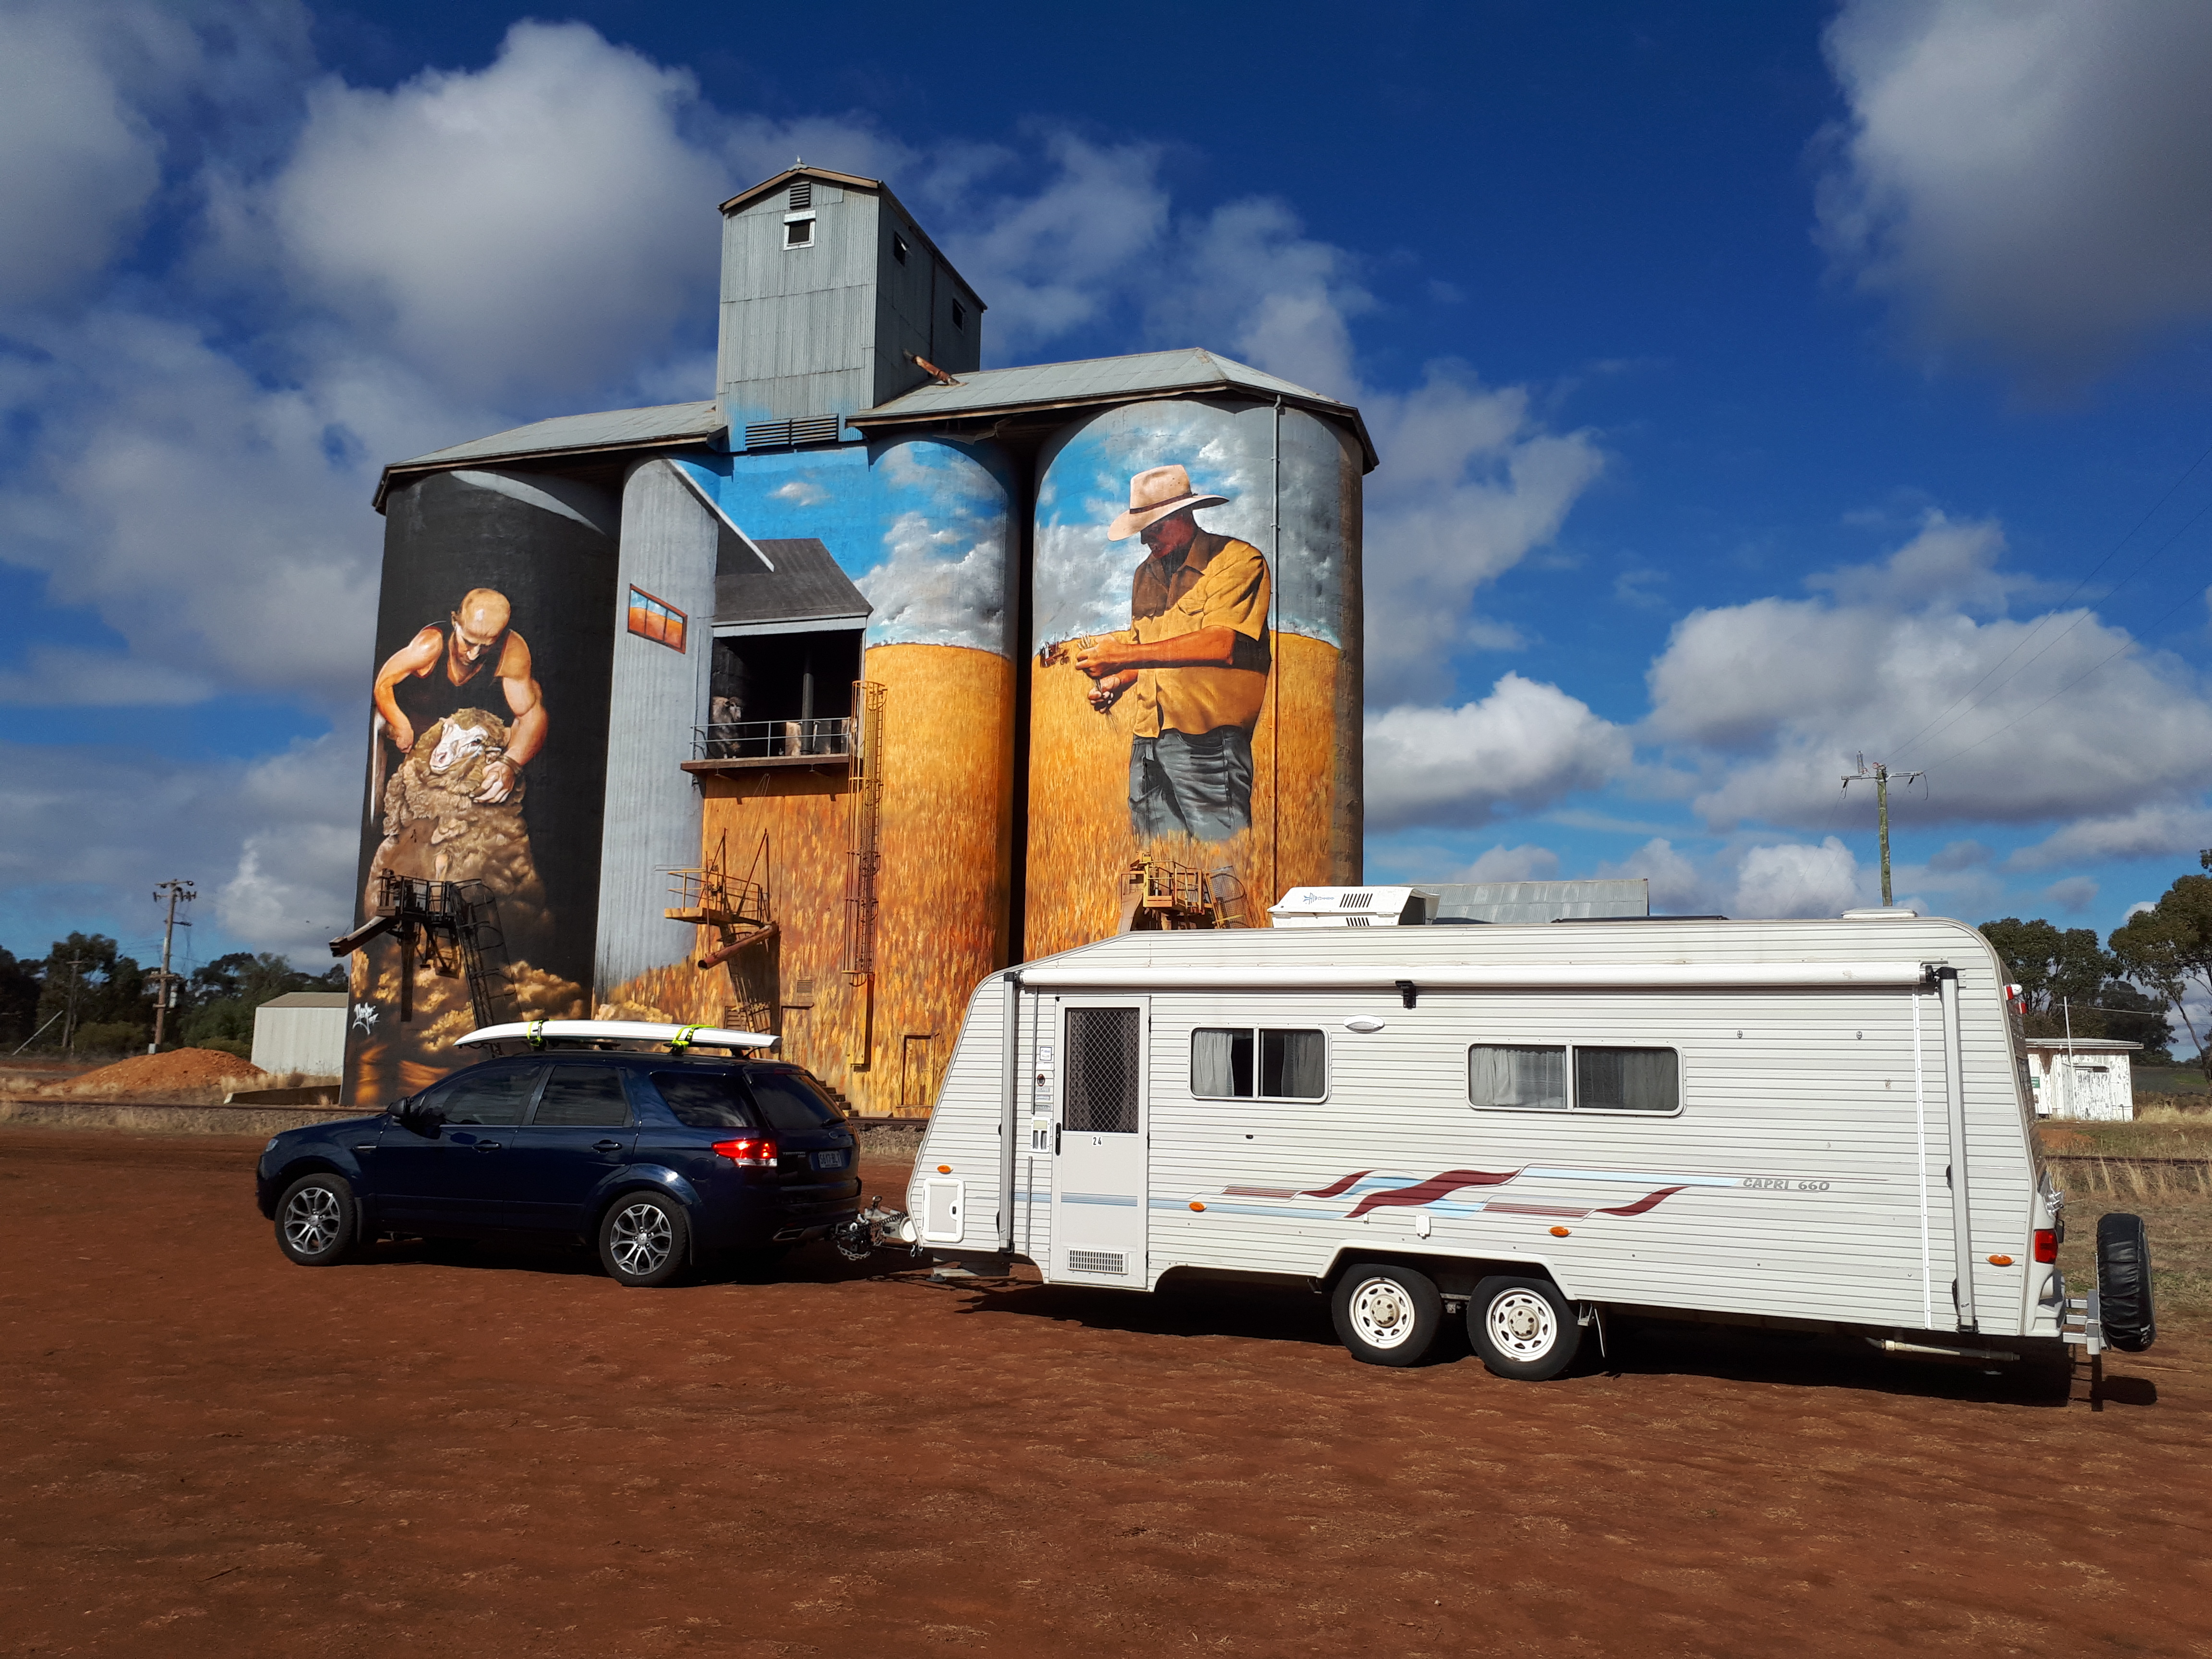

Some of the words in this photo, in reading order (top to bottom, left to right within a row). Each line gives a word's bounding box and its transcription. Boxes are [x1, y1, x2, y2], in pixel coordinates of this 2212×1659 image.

[1093, 1137, 1102, 1145] 24
[1743, 1178, 1790, 1190] CAPRI
[1798, 1180, 1830, 1190] 660
